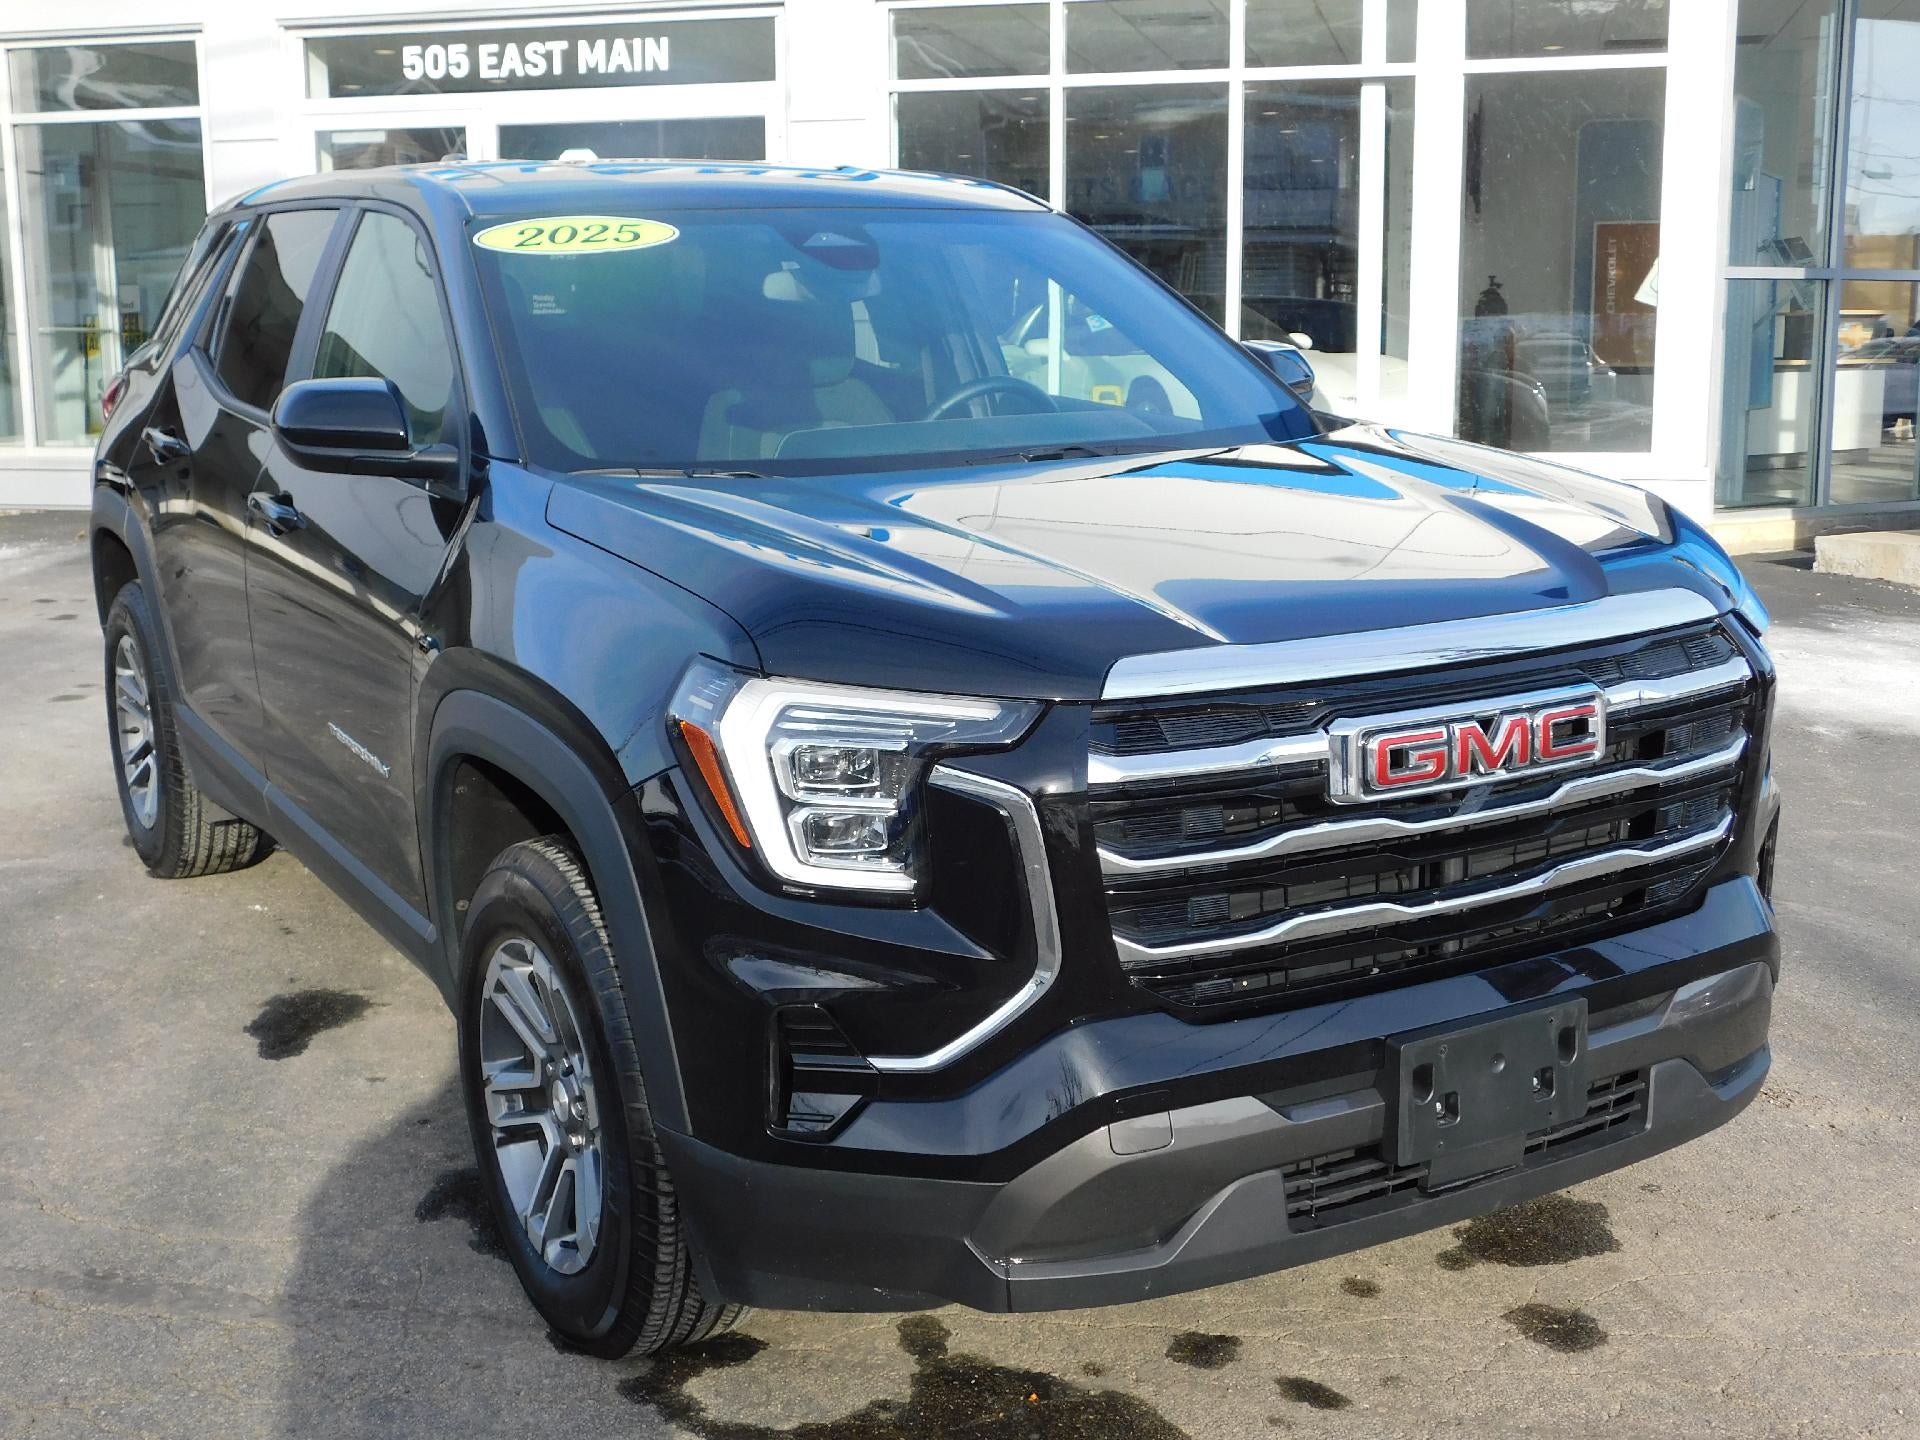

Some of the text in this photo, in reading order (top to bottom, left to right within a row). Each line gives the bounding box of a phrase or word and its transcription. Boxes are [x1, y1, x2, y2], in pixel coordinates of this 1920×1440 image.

[402, 36, 669, 80] 505 EAST MAIN
[514, 223, 642, 248] 2025
[1372, 703, 1600, 789] GMC
